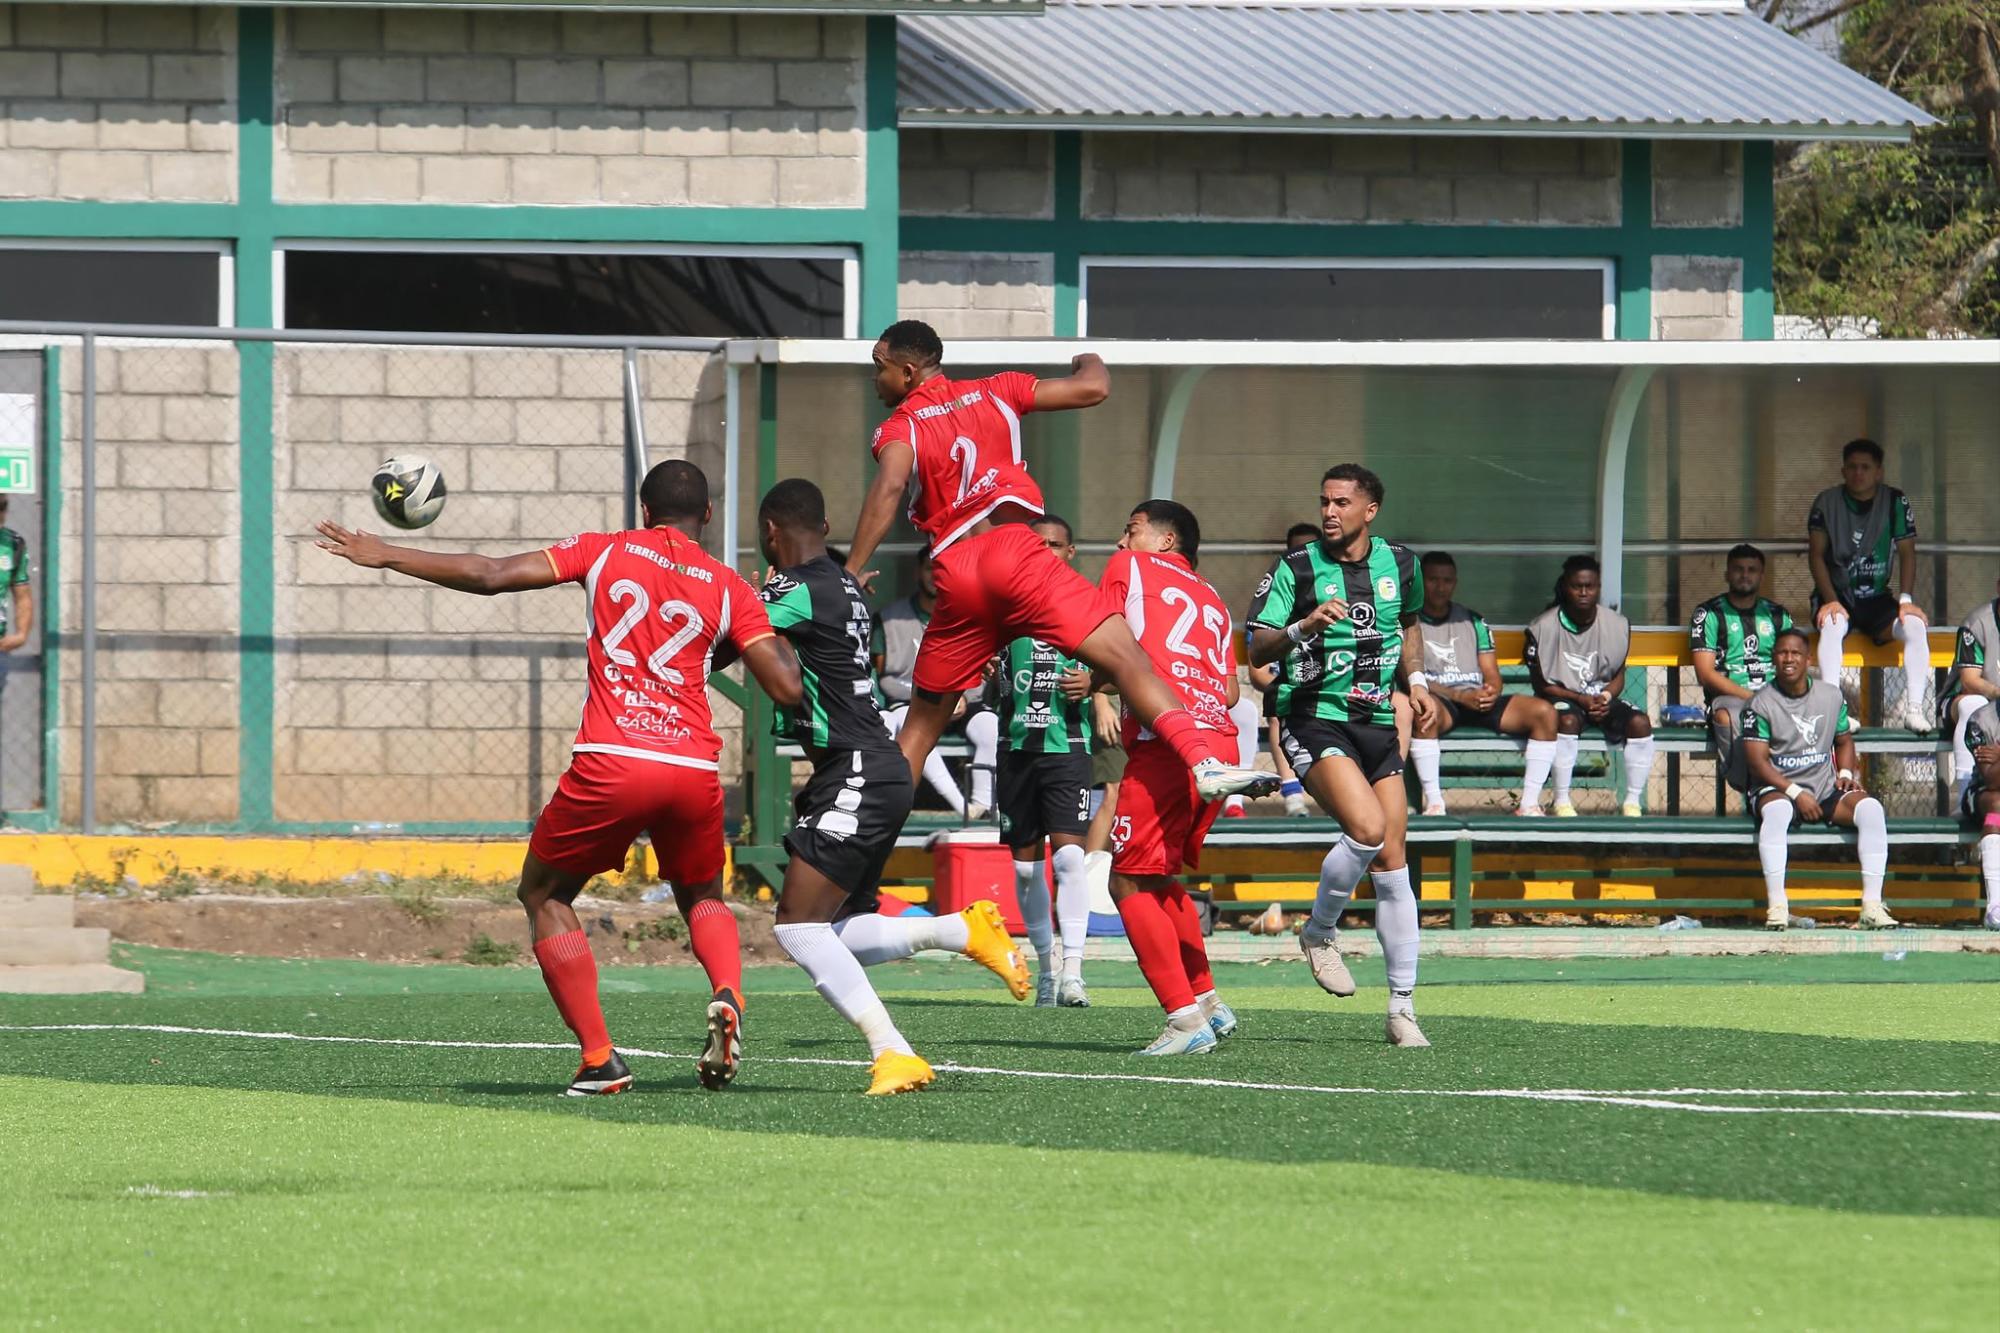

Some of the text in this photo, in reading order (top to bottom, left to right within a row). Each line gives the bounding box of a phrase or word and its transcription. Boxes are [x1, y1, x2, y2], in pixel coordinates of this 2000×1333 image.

[950, 435, 977, 502] 2
[625, 542, 713, 584] FERRELECTRICOS
[602, 579, 703, 685] 22
[1034, 670, 1060, 680] SÚP
[1079, 788, 1090, 810] 31
[1110, 815, 1131, 842] 25
